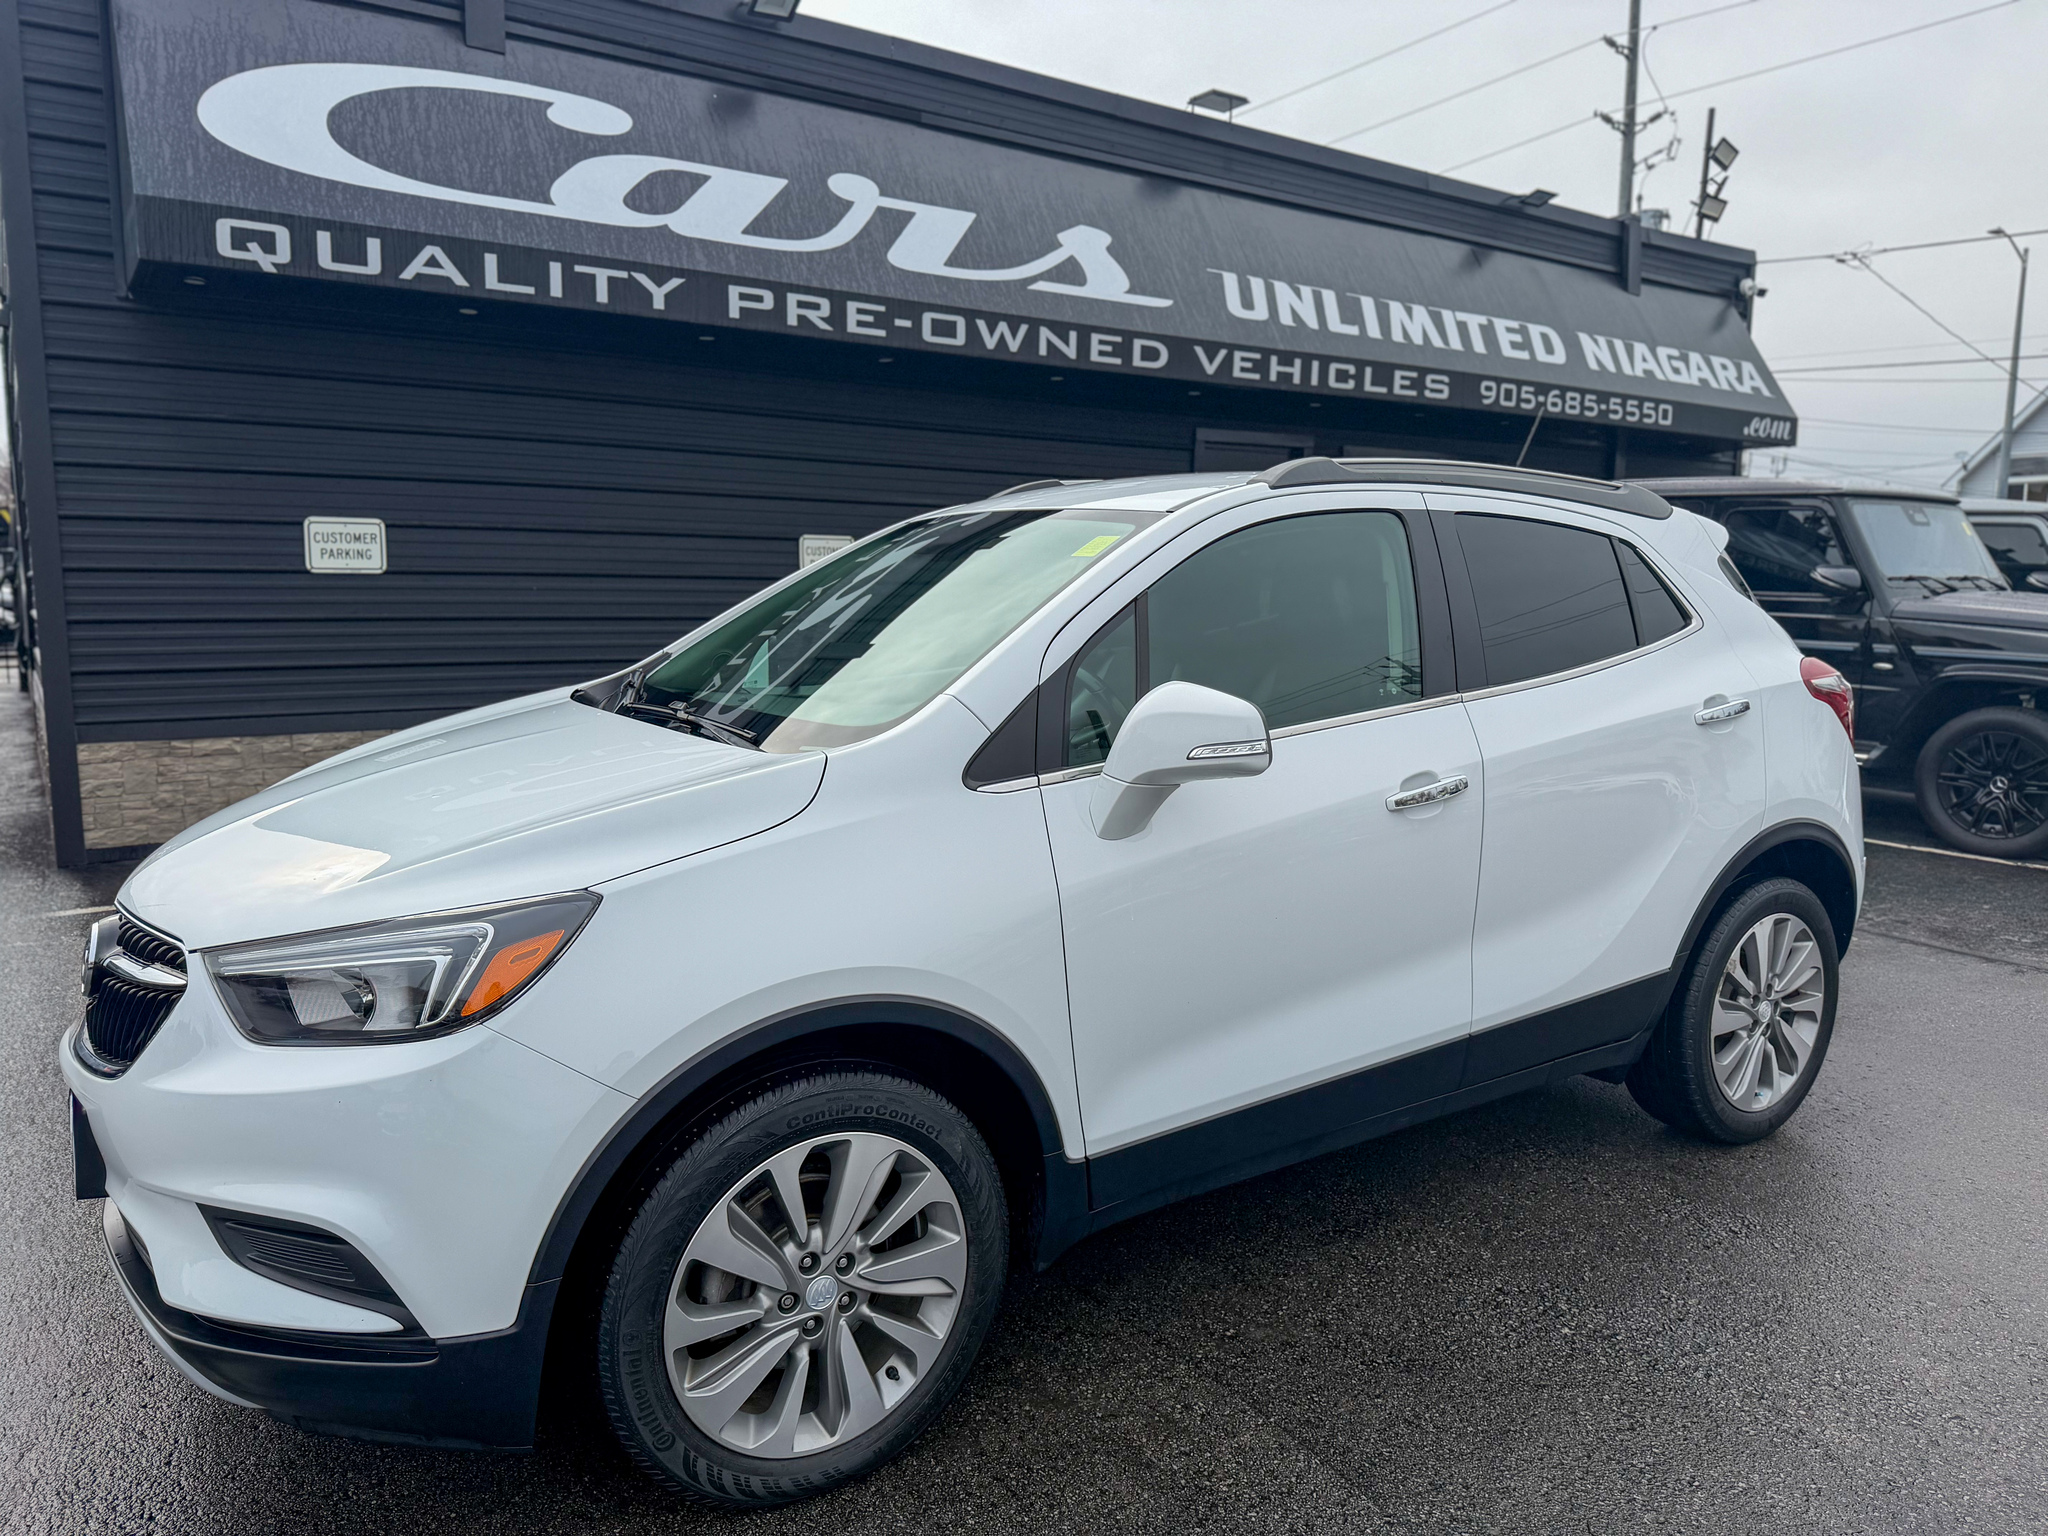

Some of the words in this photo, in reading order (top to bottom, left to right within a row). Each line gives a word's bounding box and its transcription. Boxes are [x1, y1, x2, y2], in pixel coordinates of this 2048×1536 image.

[196, 62, 1174, 309] Cars
[214, 217, 686, 311] QUALITY
[727, 284, 1170, 370] PRE-OWNED
[1193, 345, 1450, 400] VEHICLES
[1206, 268, 1567, 365] UNLIMITED
[1576, 331, 1776, 398] NIAGARA
[1479, 380, 1673, 426] 905-685-5550
[1743, 417, 1793, 440] .com
[313, 531, 378, 545] CUSTOMER
[320, 547, 372, 560] PARKING
[786, 1103, 943, 1141] ContiProContact
